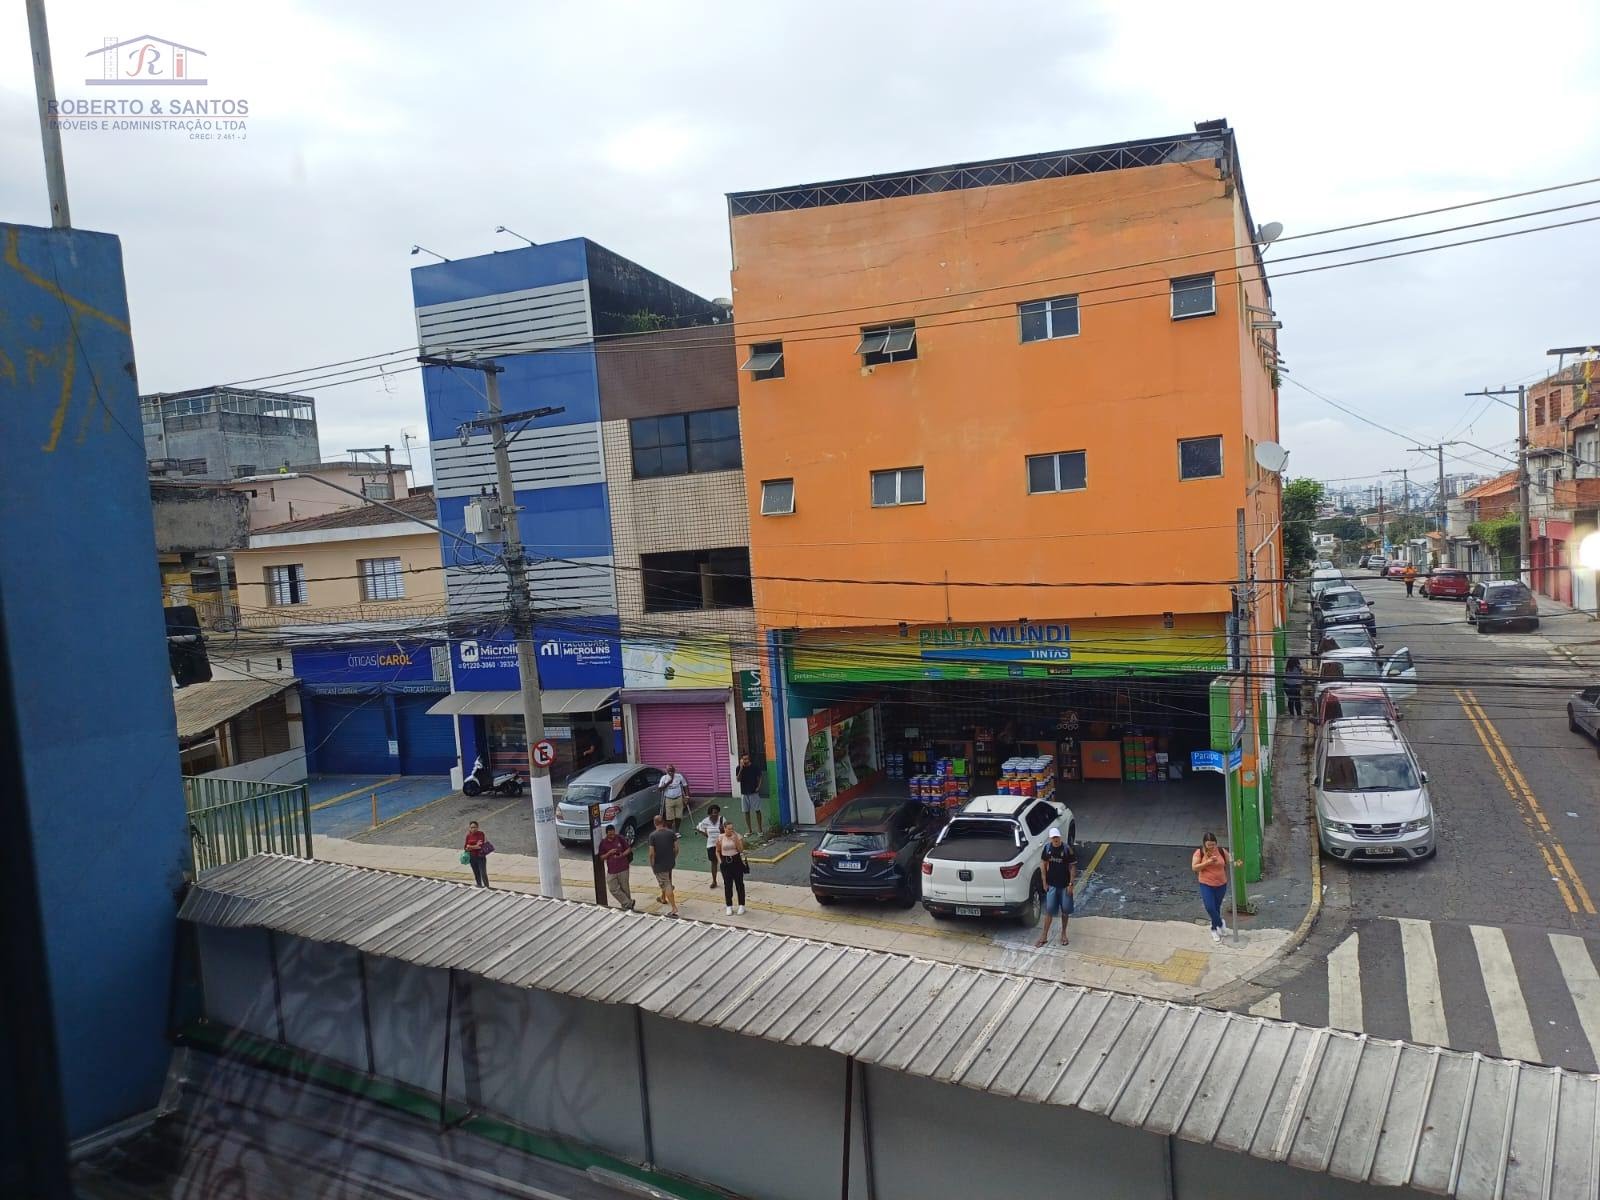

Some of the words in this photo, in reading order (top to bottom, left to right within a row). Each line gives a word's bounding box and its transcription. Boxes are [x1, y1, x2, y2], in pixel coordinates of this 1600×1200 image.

[919, 627, 985, 646] PINTA
[989, 624, 1071, 643] MUNDI
[563, 646, 611, 655] MICROLINS
[1030, 649, 1069, 659] TINTAS
[379, 654, 413, 666] CAROL
